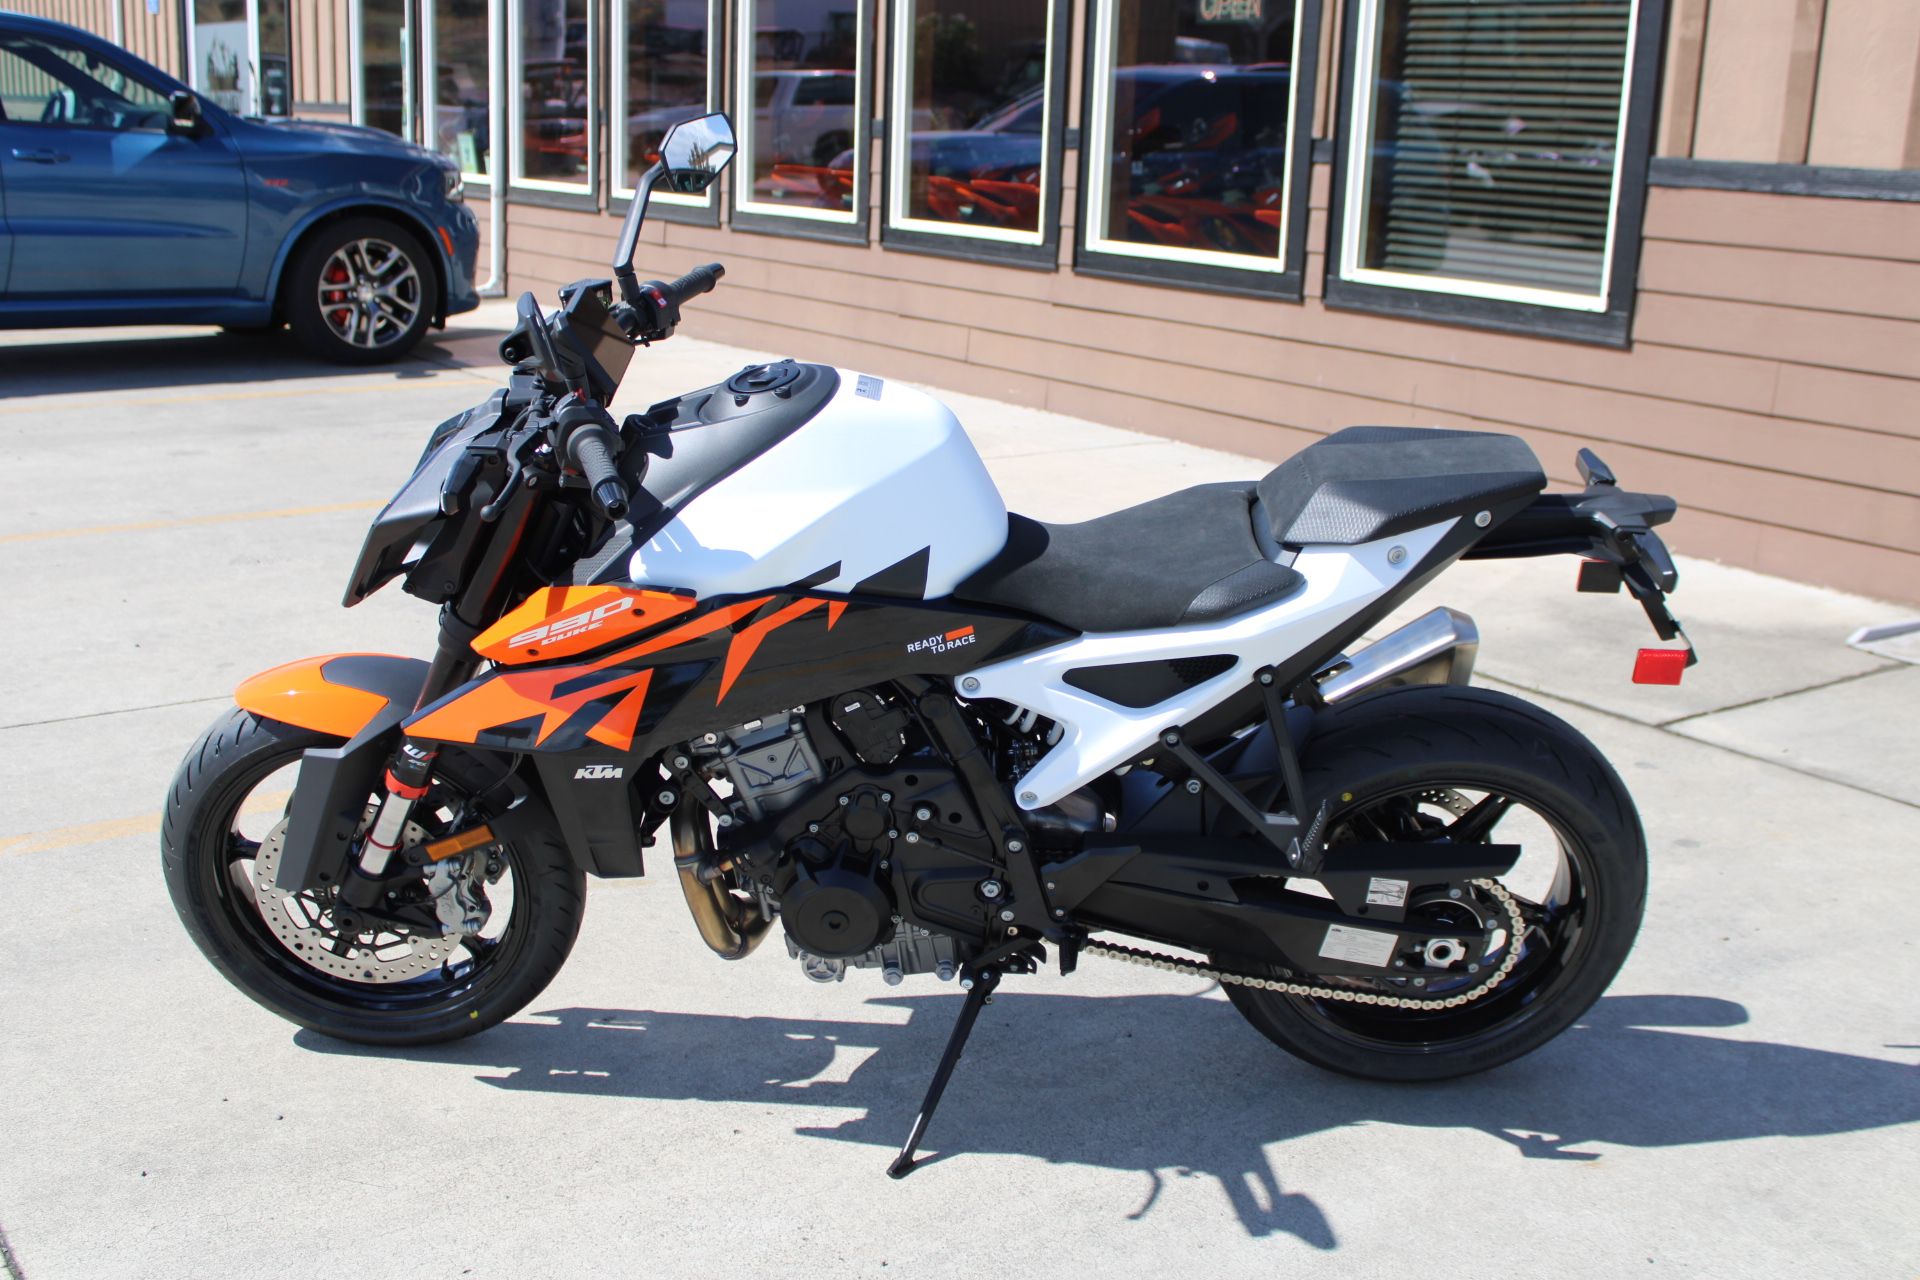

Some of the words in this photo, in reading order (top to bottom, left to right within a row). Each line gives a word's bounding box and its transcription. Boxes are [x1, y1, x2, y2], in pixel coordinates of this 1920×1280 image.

[508, 596, 635, 648] 990
[541, 620, 605, 646] DUKE
[906, 634, 943, 653] READY
[930, 644, 946, 654] TO
[946, 634, 976, 650] RACE
[573, 764, 624, 779] KTM
